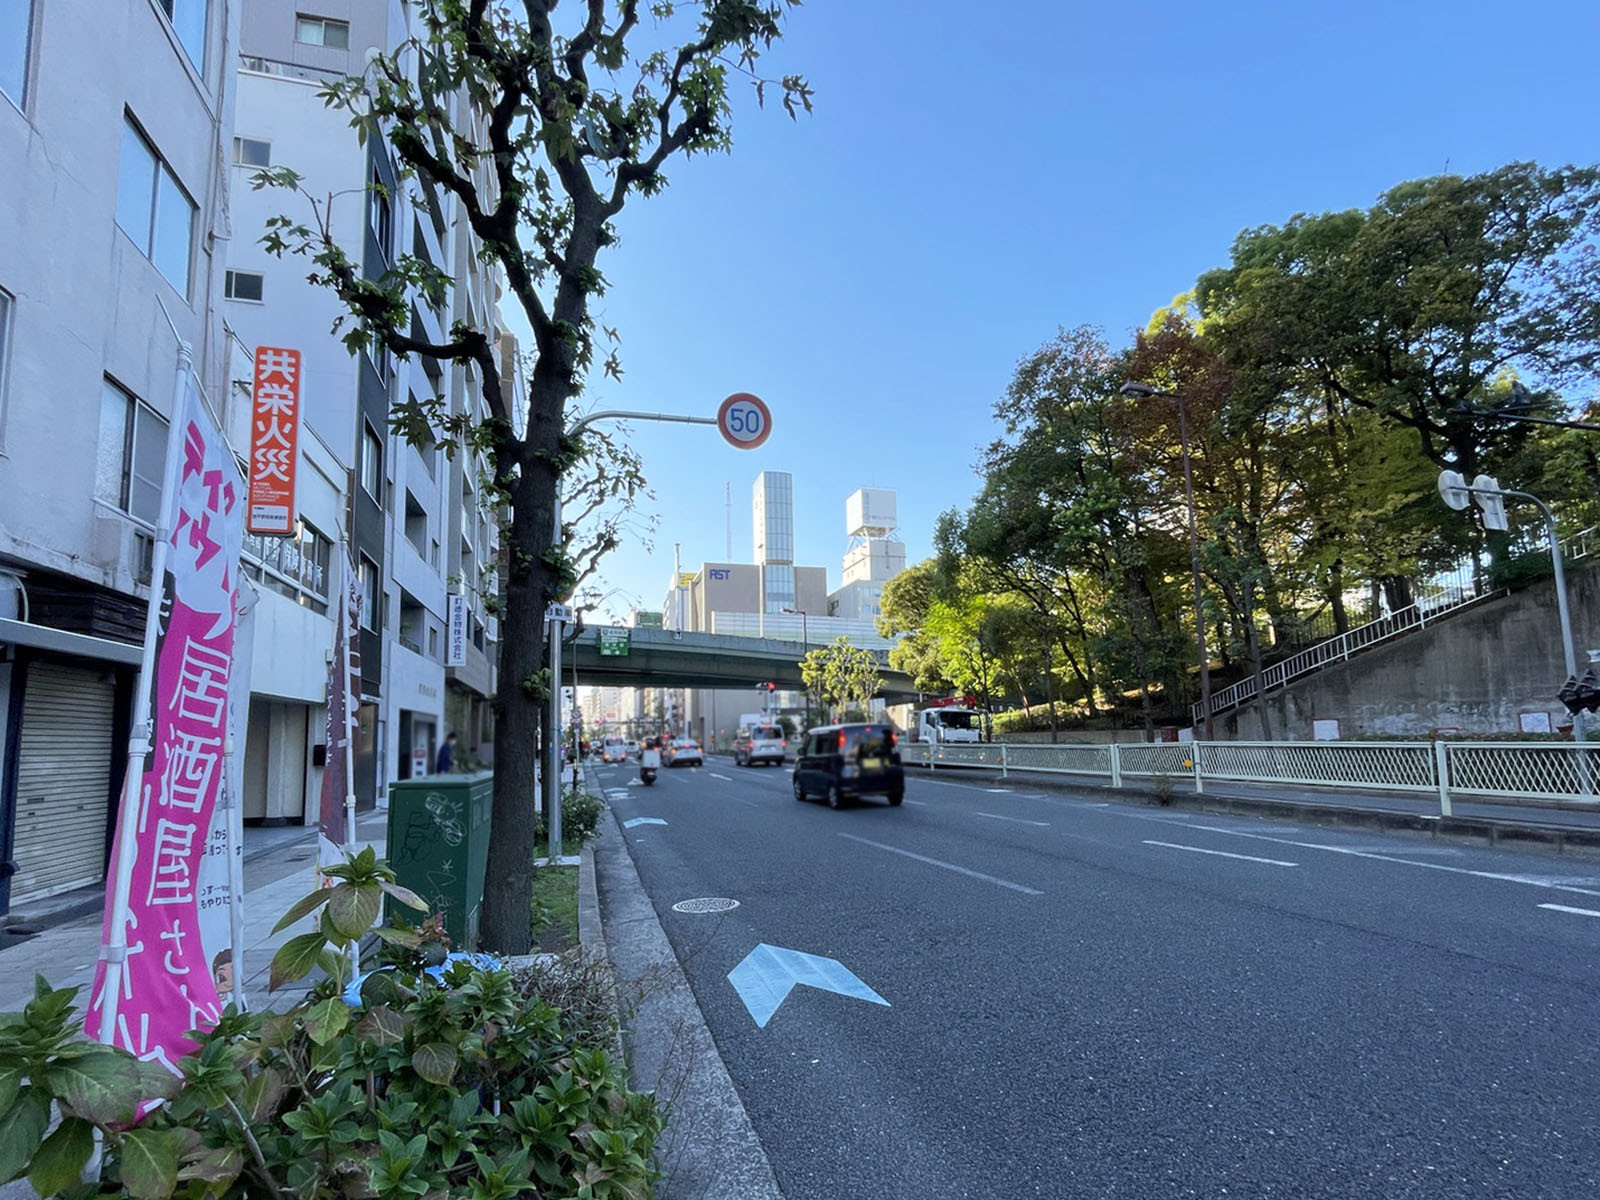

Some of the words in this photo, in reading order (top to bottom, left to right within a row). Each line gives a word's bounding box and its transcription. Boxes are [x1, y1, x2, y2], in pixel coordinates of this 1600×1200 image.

[254, 350, 296, 482] 共栄火災
[731, 408, 759, 433] 50
